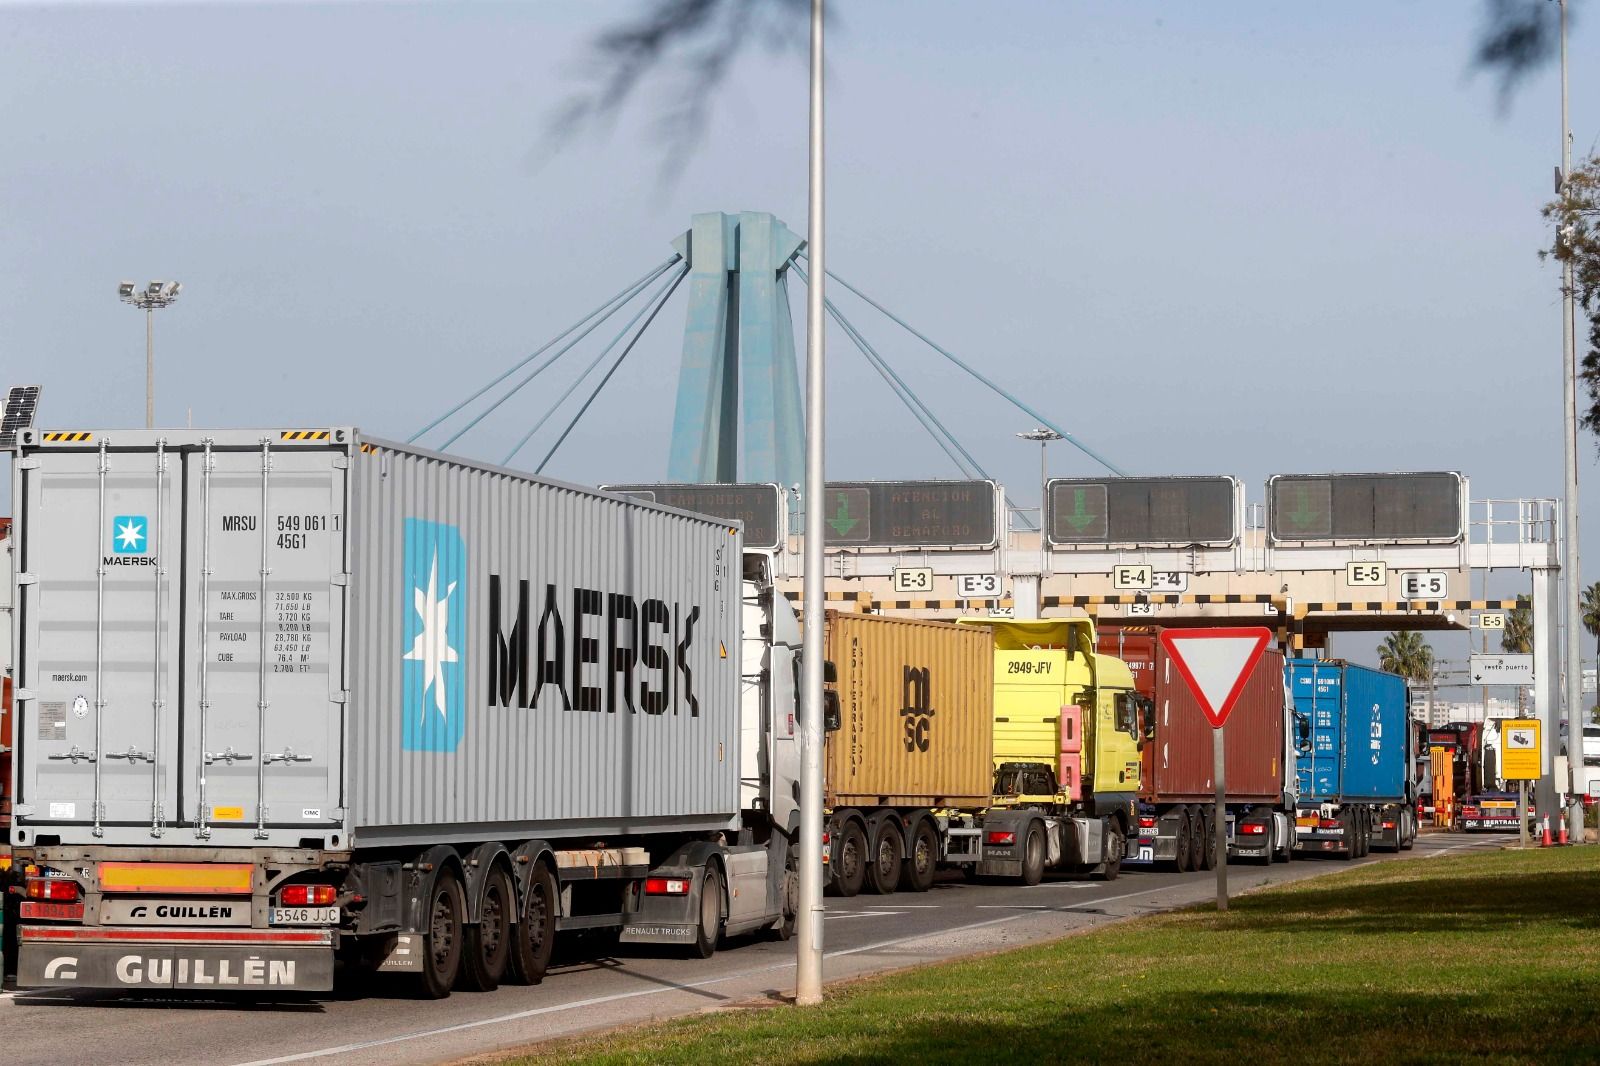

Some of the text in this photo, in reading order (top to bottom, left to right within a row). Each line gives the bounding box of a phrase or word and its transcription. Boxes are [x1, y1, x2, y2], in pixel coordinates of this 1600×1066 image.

[222, 515, 340, 531] MRSU 549 061 1
[276, 533, 307, 549] 45G1
[103, 556, 157, 566] MAERSK
[900, 572, 926, 587] E-3
[1120, 569, 1146, 585] E-4
[1353, 566, 1380, 582] E-5
[964, 576, 996, 592] E-3
[1407, 577, 1441, 593] E-5
[303, 592, 312, 601] KG
[302, 602, 311, 611] LB
[219, 611, 234, 621] TARE
[301, 612, 311, 621] KG
[1483, 616, 1501, 627] E-5
[302, 623, 311, 632] LB
[219, 632, 247, 642] PAYLOAD
[302, 633, 312, 642] KG
[301, 643, 311, 652] LB
[488, 573, 701, 718] MAERSK
[217, 653, 234, 662] CUBE
[1007, 661, 1052, 675] 2949-JFV
[1505, 664, 1529, 672] puerto
[52, 672, 88, 682] maersk.com
[850, 636, 858, 777] MEDITERRANEAN
[276, 907, 337, 922] 5546 JJC
[625, 927, 691, 936] RENAULT TRUCKS
